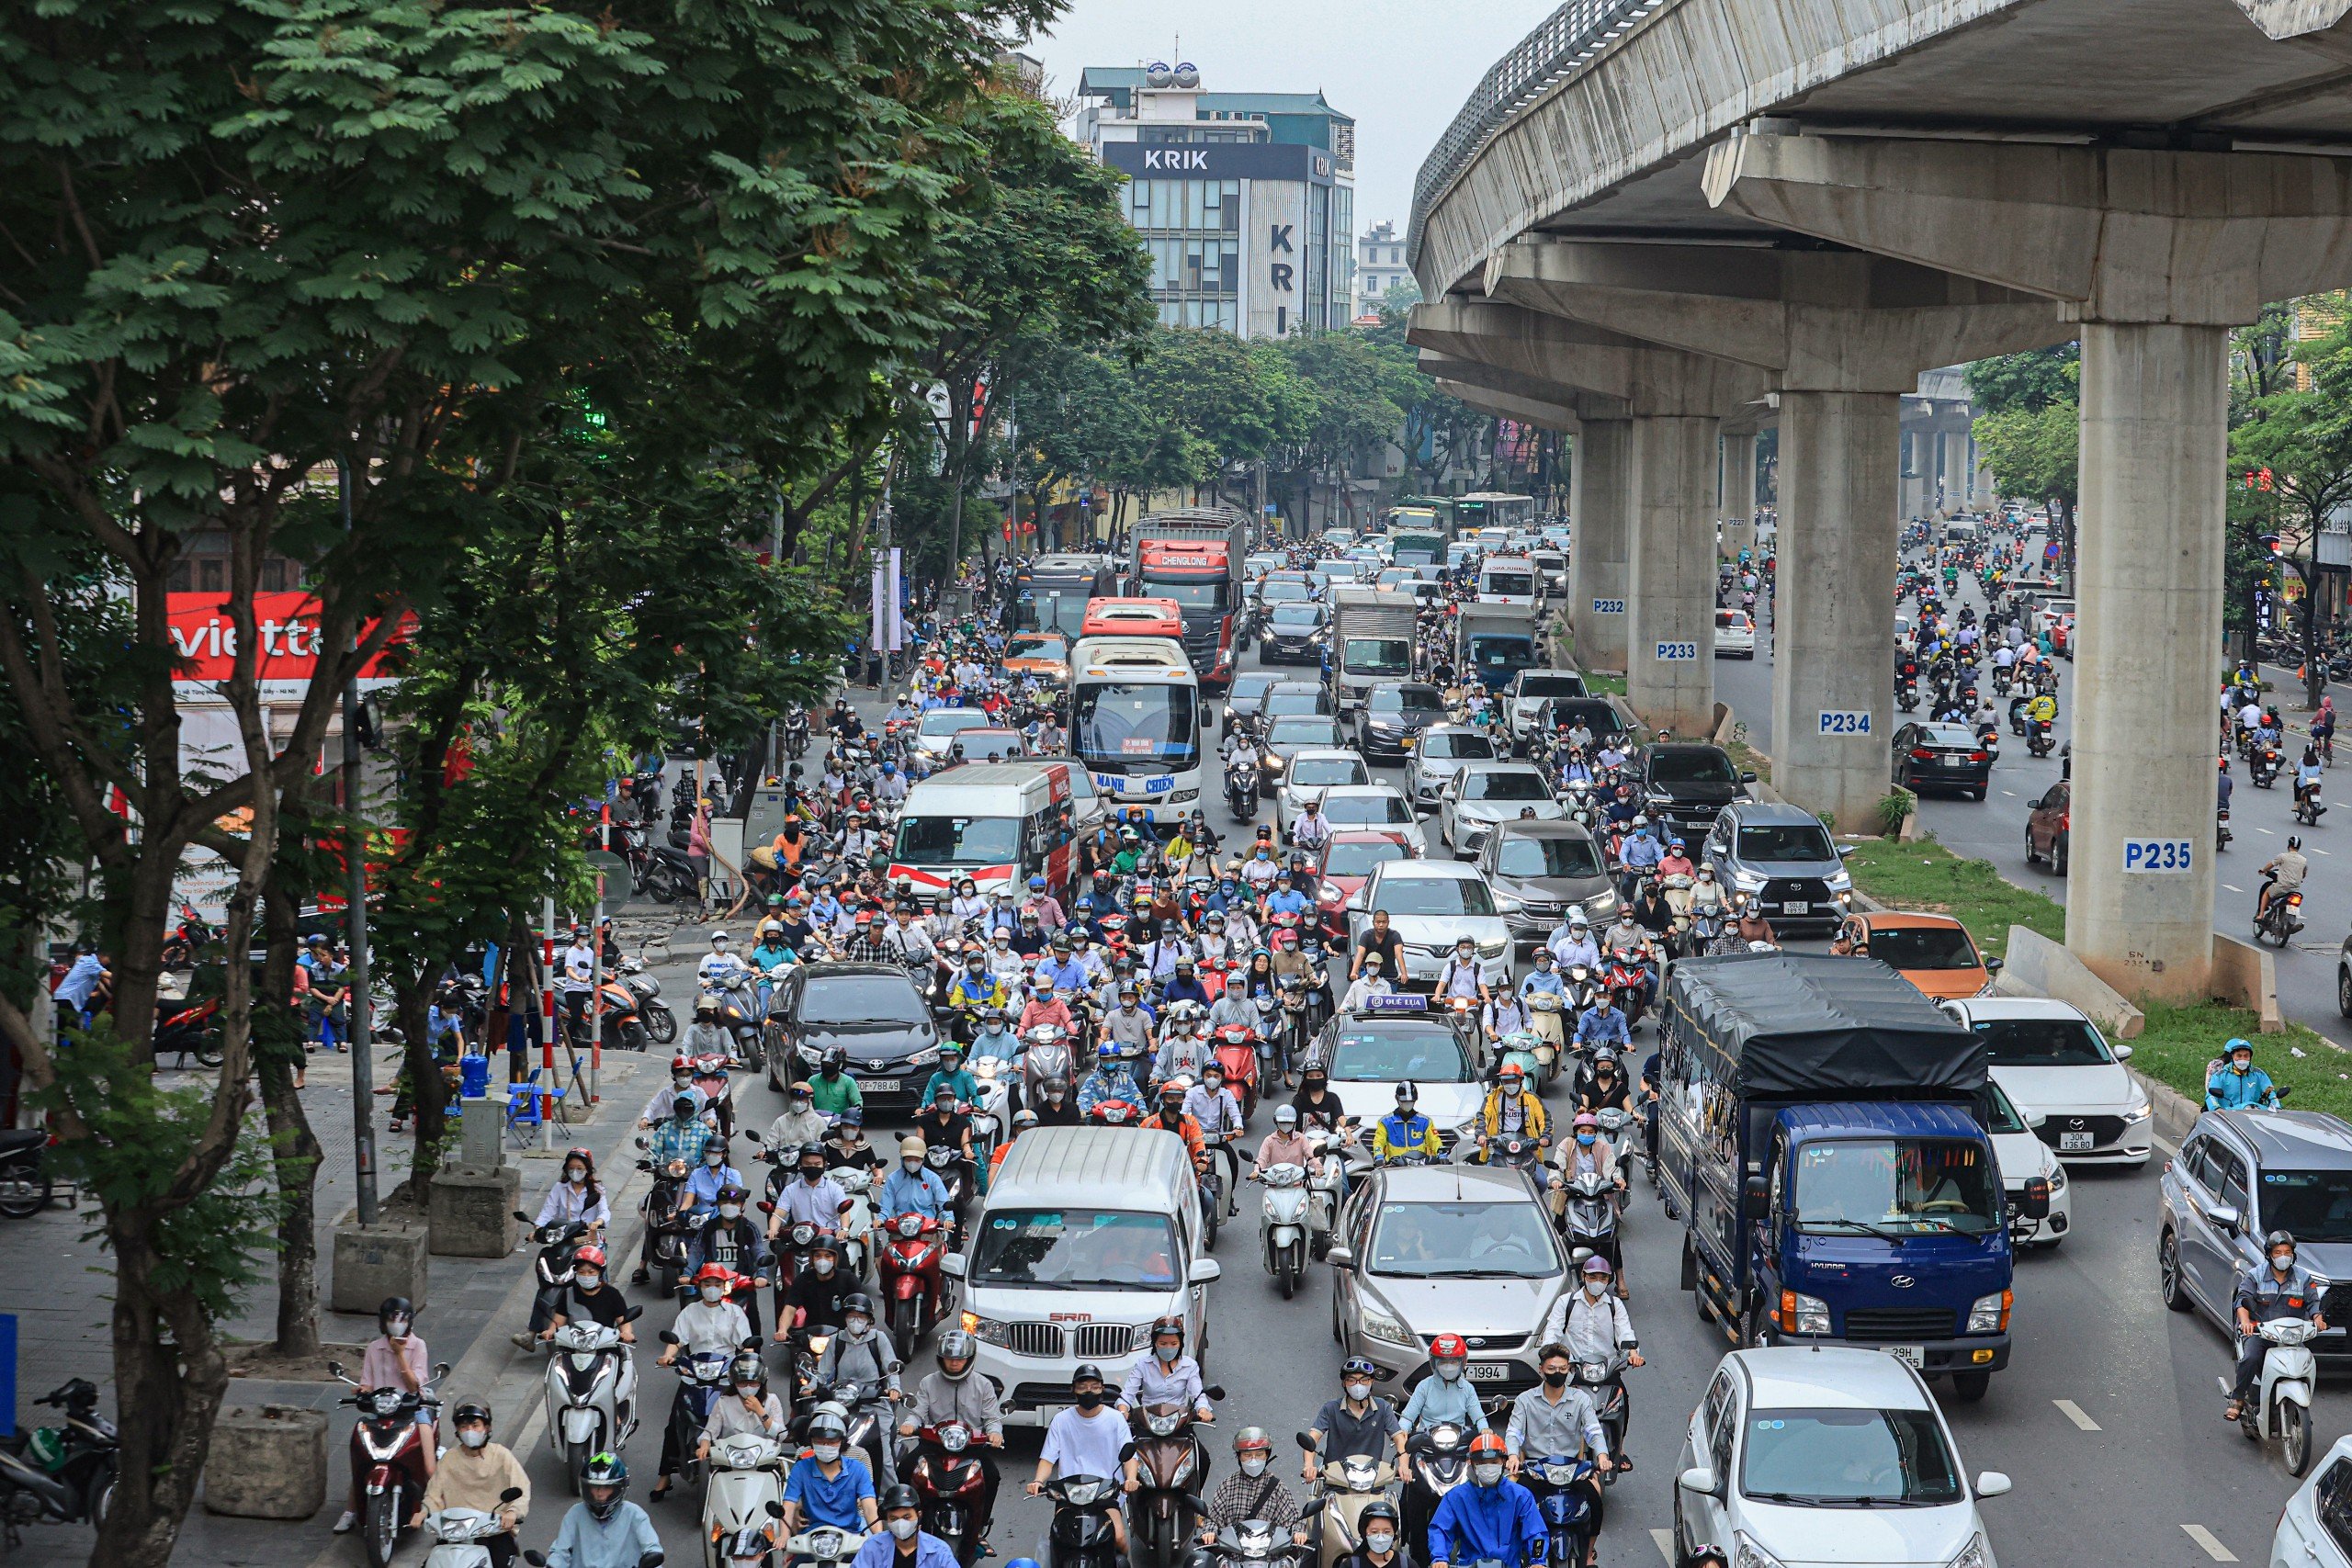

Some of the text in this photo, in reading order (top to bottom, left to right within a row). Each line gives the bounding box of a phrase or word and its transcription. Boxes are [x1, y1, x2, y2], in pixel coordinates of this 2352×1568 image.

[1145, 150, 1208, 170] KRIK
[1316, 155, 1330, 177] KRIK
[1161, 556, 1207, 566] CHENGLONG
[1594, 600, 1623, 613] P232
[1657, 644, 1695, 659] P233
[1905, 664, 1915, 673] 20
[1821, 714, 1870, 733] P234
[2126, 842, 2190, 869] P235
[1411, 1128, 1423, 1139] be
[2064, 1141, 2091, 1149] 136.80
[1811, 1262, 1846, 1270] HYUNDAI
[1049, 1313, 1091, 1323] SRM
[1893, 1348, 1912, 1358] 29H
